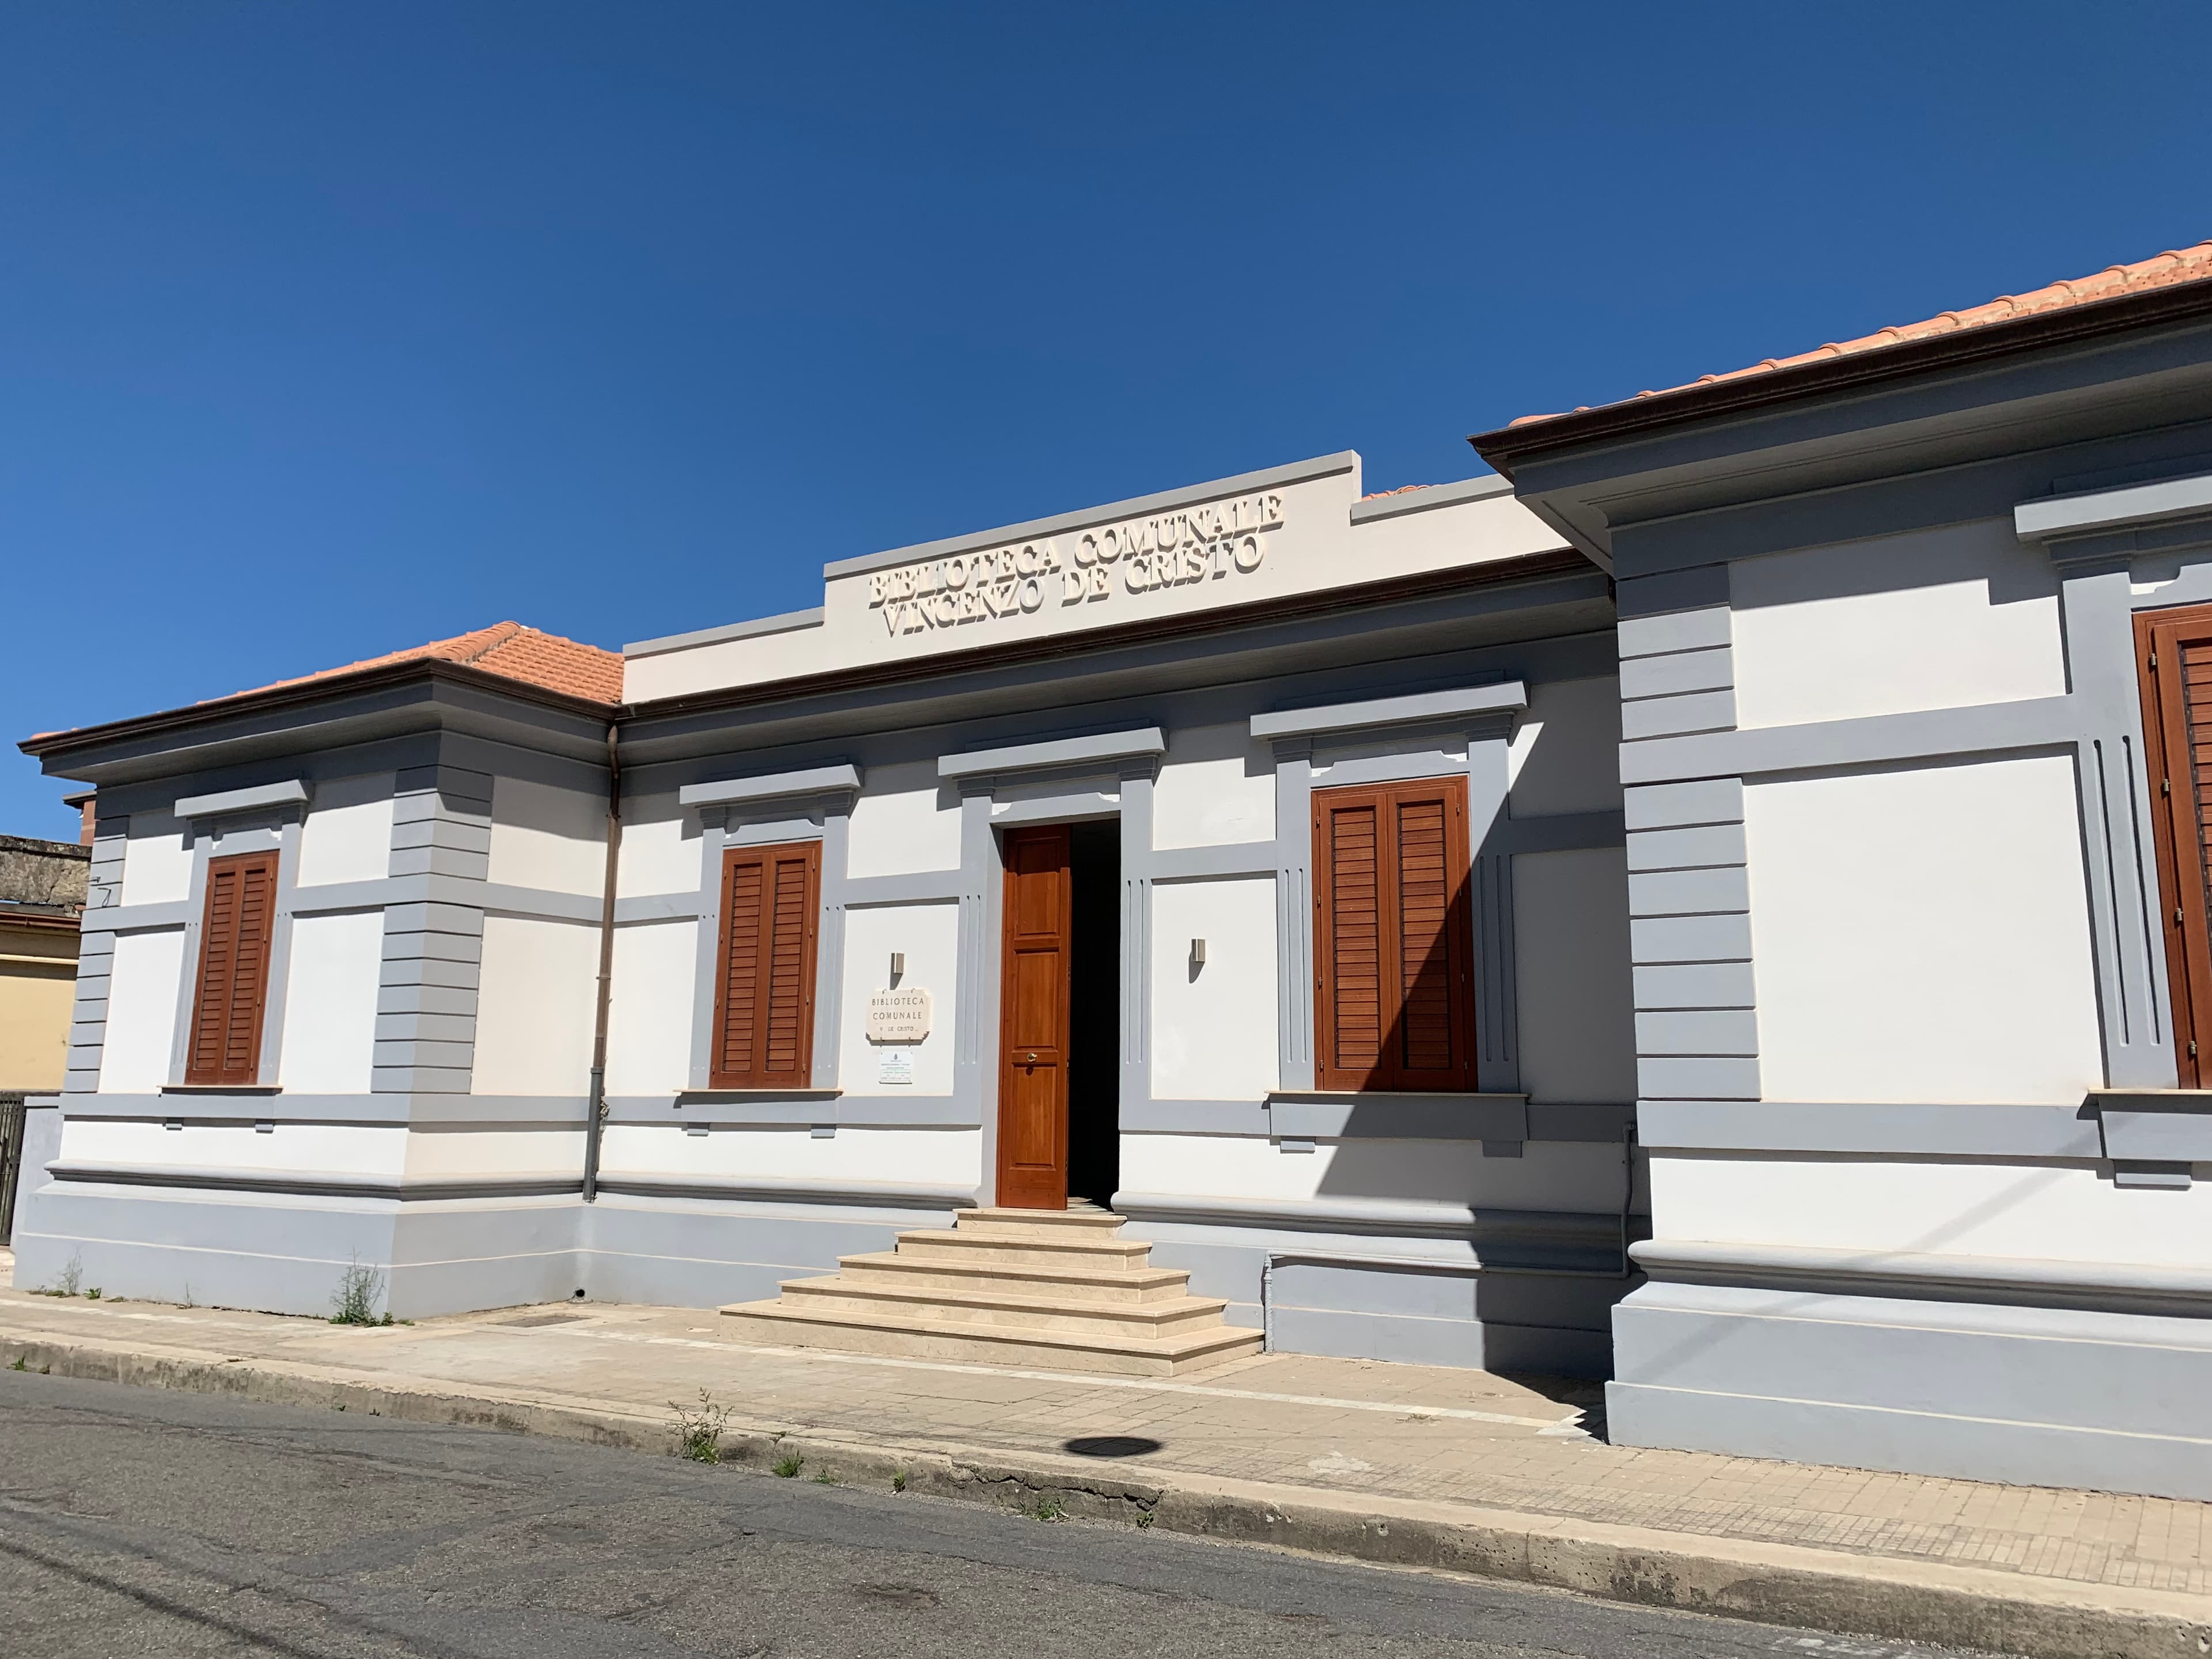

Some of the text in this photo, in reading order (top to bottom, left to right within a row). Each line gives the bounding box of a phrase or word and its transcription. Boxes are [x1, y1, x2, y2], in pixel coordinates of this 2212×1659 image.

[869, 493, 1284, 608] BIBLIOTECA COMUNALE
[883, 533, 1264, 637] VINCENZO DE CRISTO
[872, 997, 924, 1006] BIBLIOTECA
[873, 1012, 922, 1020] COMUNALE
